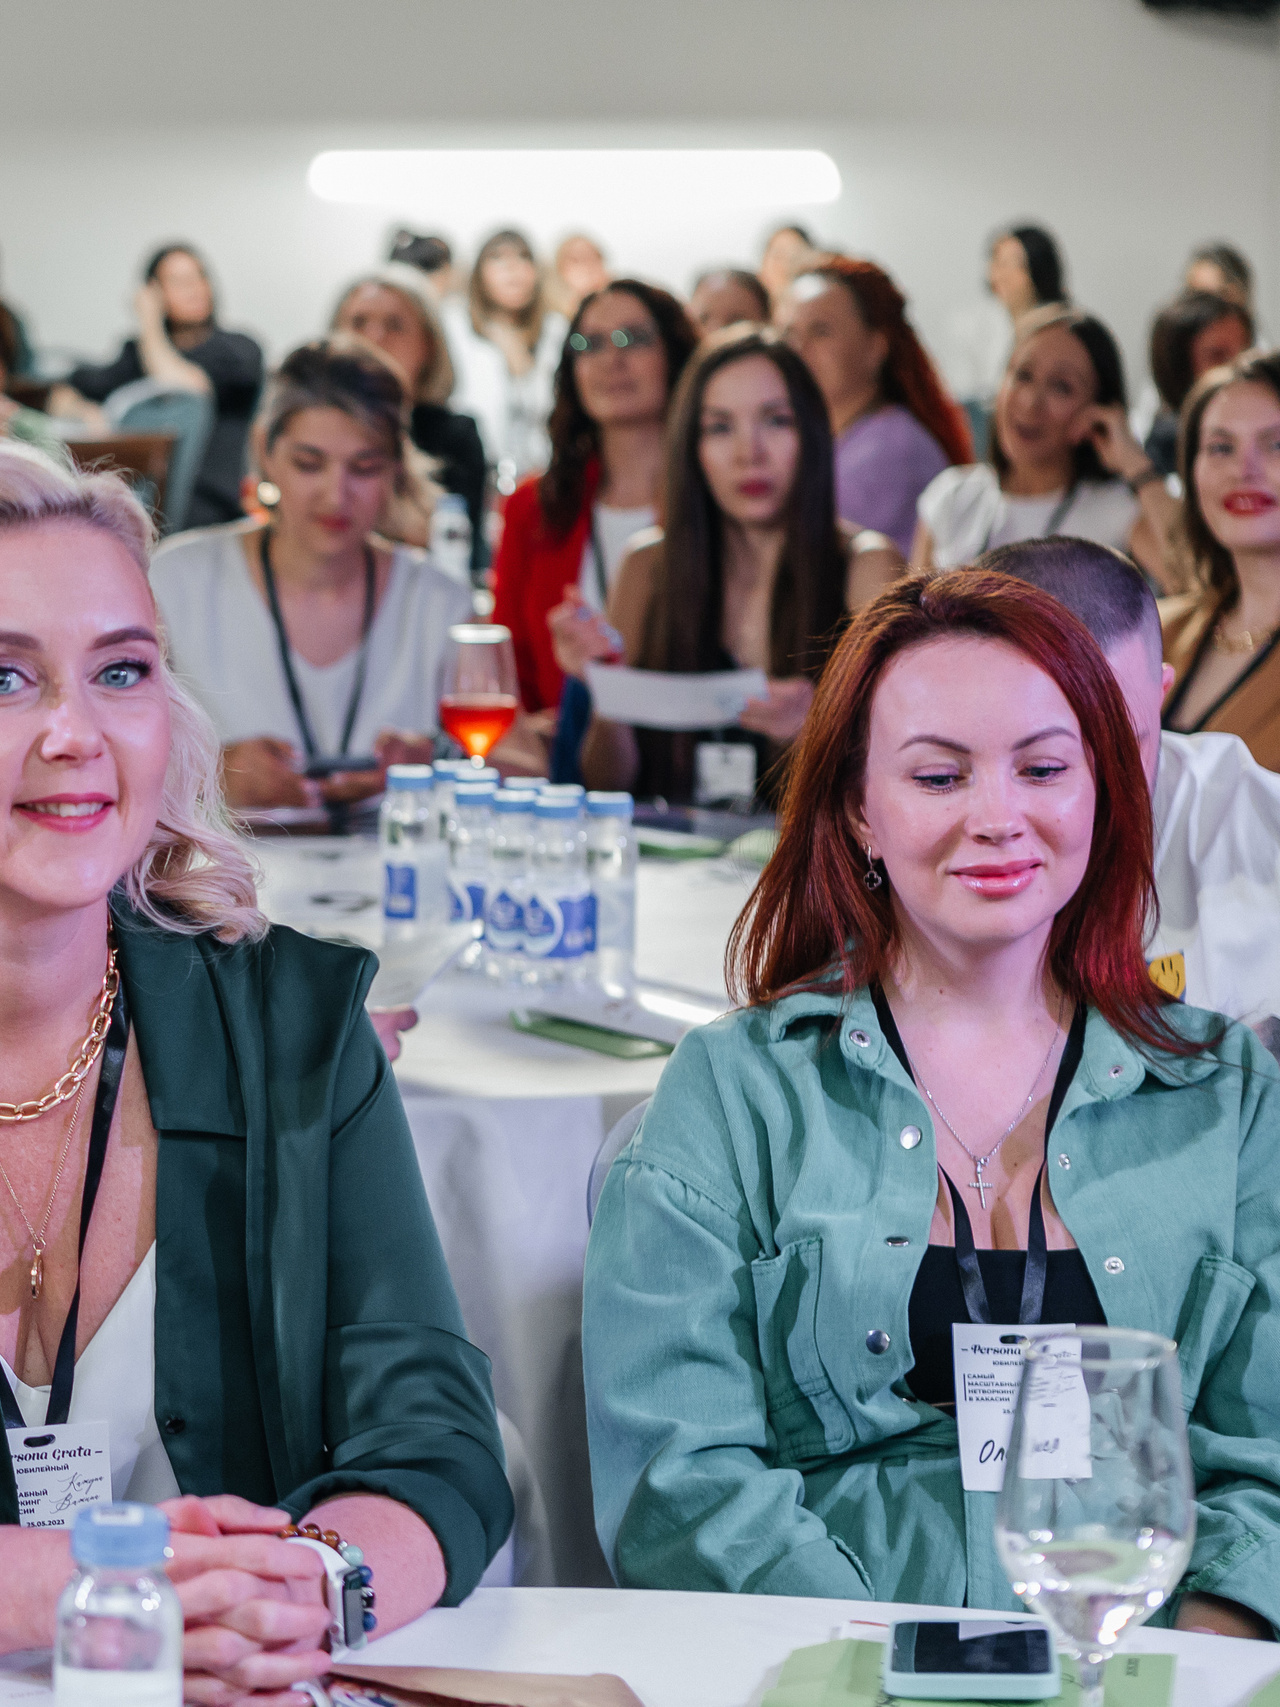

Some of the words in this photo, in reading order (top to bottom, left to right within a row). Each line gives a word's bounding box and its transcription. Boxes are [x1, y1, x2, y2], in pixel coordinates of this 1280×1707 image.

[970, 1344, 1022, 1355] Persona
[52, 1446, 92, 1461] Grata
[16, 1463, 70, 1475] ЮБИЛЕЙНЫЙ
[18, 1488, 48, 1498] АБНЫЙ
